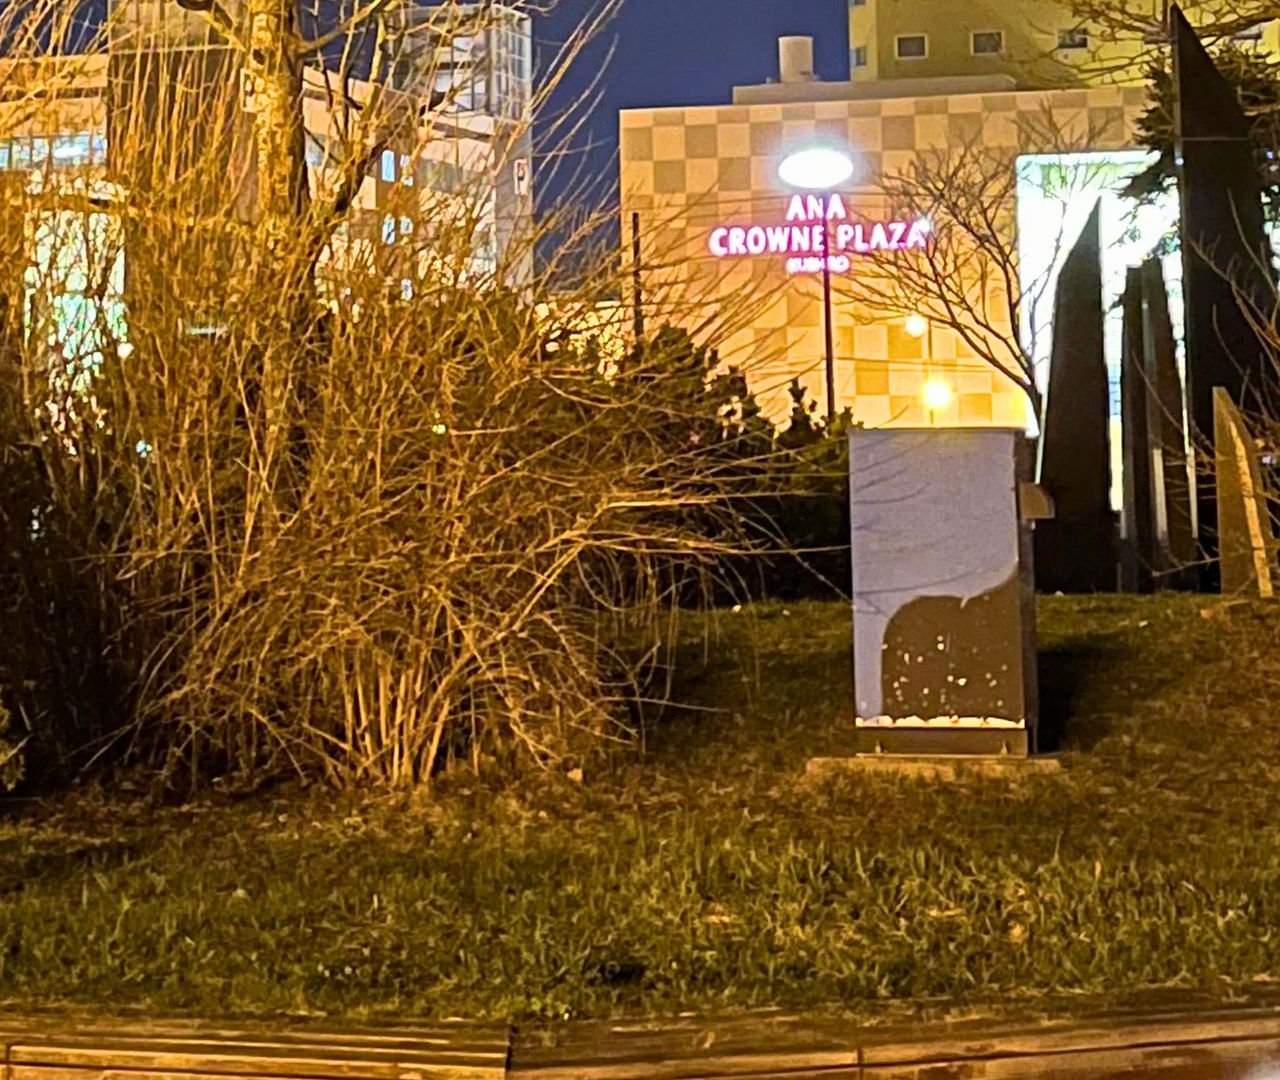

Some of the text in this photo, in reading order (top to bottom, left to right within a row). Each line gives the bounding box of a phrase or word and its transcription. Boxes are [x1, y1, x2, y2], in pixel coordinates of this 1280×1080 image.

[786, 193, 846, 220] ANA
[709, 220, 928, 256] CROWNE PLAZA
